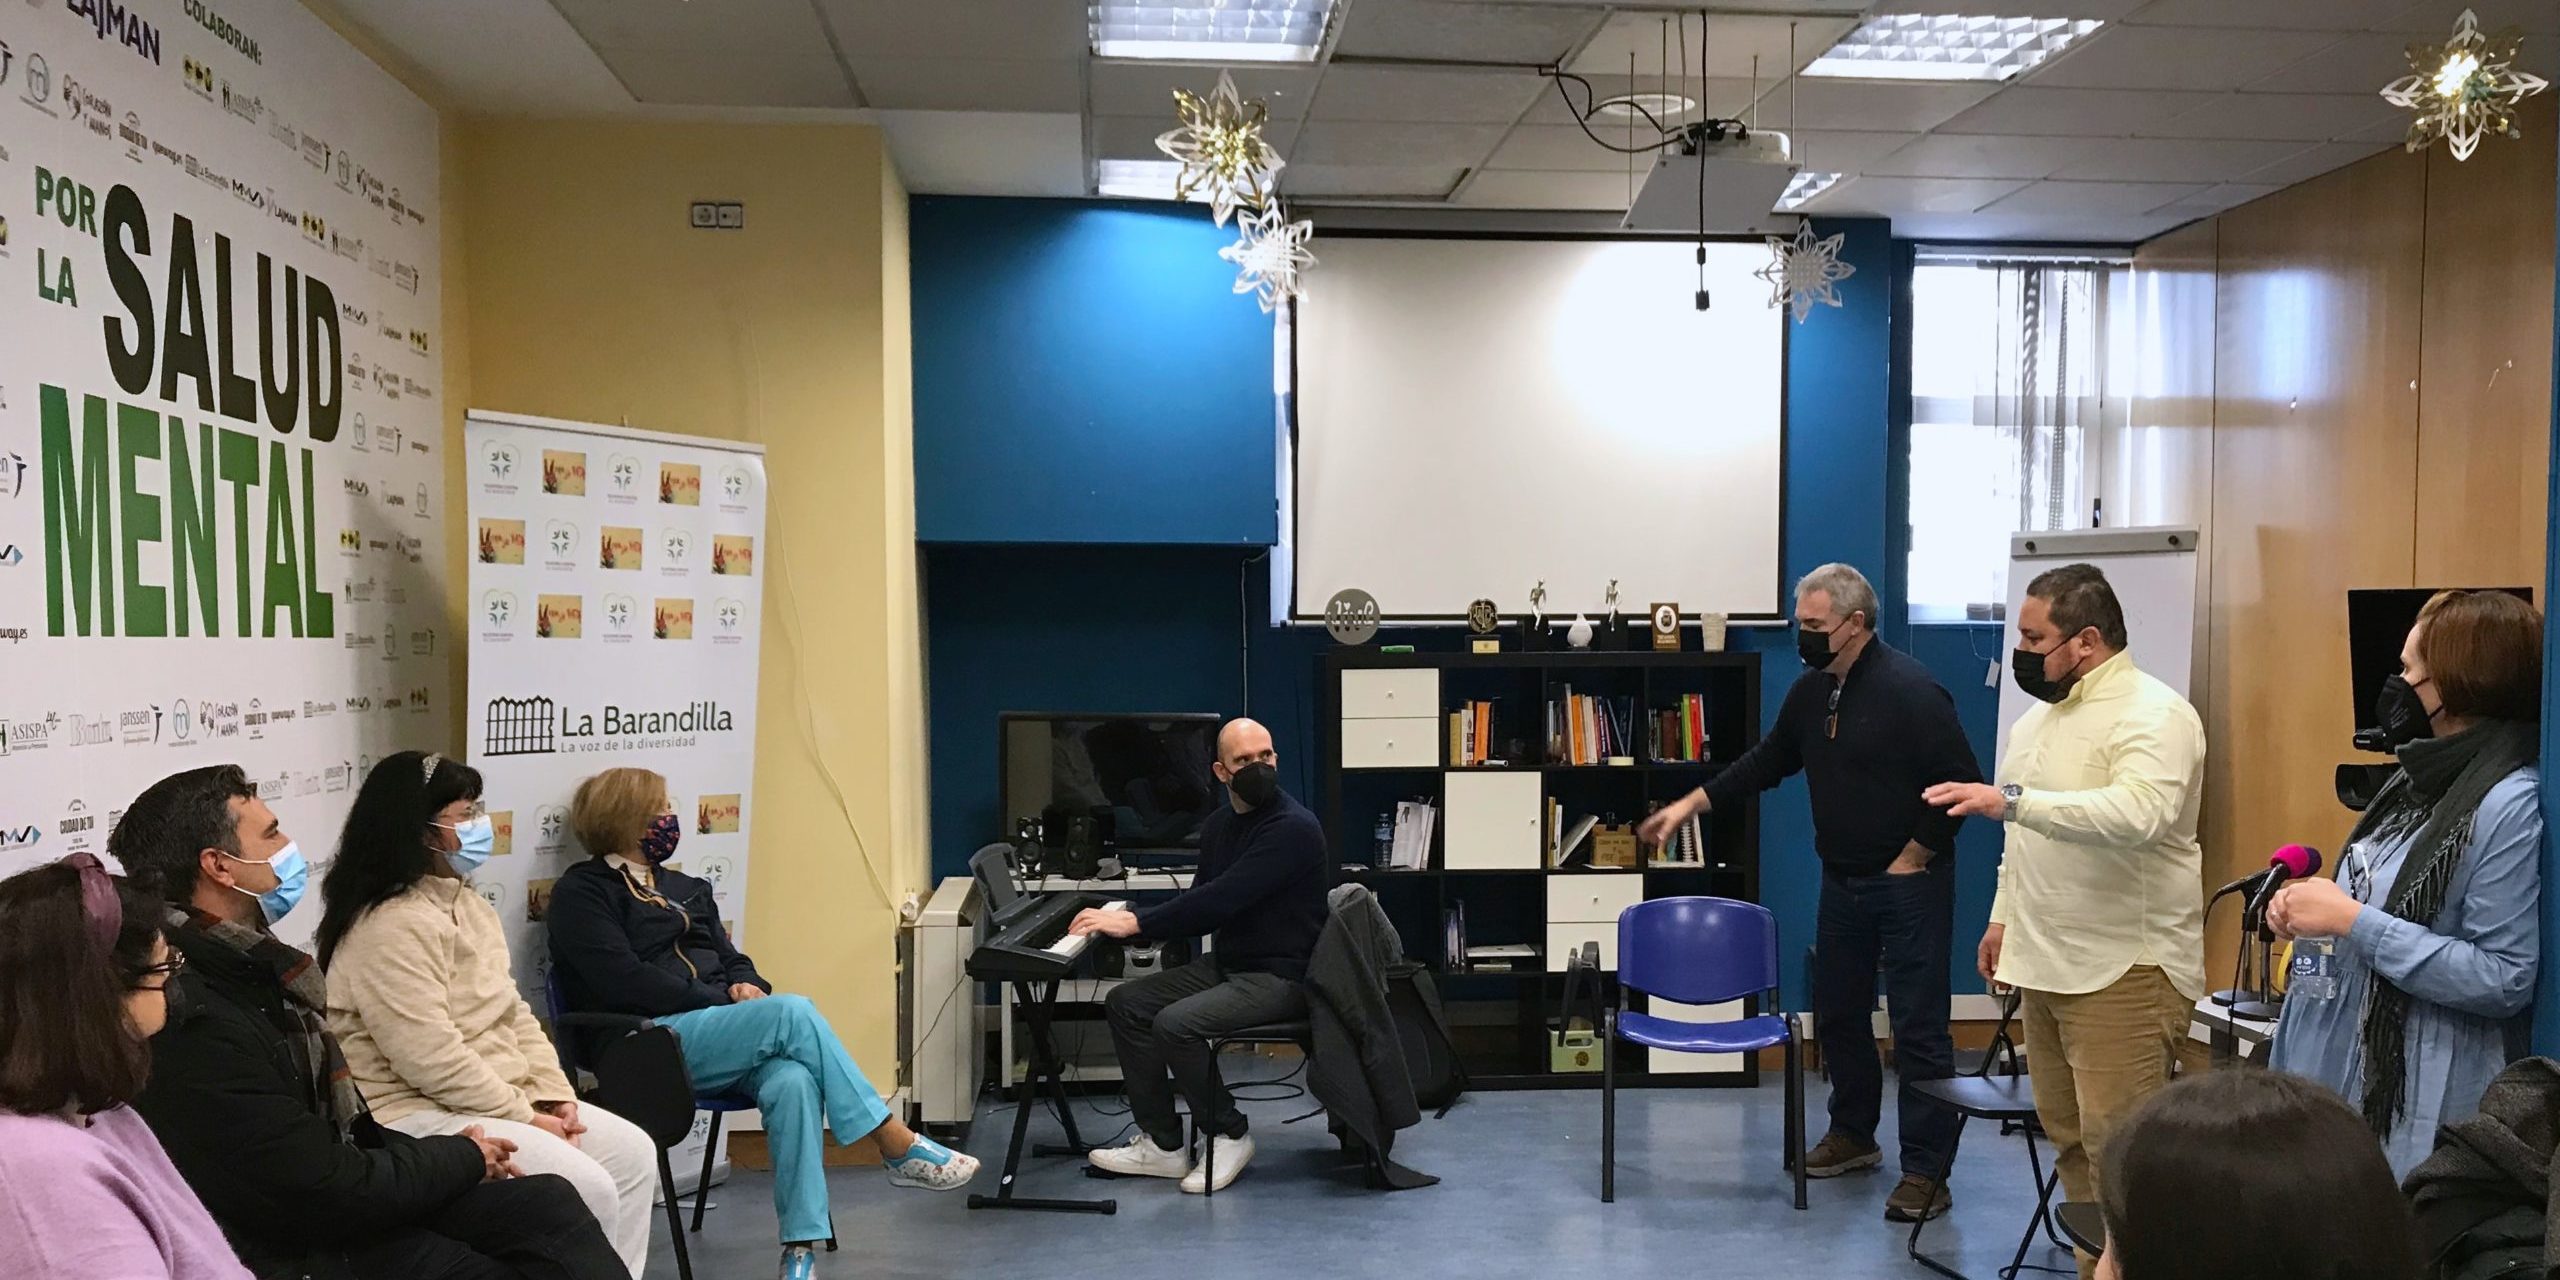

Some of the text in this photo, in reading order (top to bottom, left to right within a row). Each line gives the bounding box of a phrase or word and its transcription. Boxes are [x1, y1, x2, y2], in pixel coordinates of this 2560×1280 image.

[184, 0, 262, 66] COLABORAN:
[35, 165, 97, 238] POR
[37, 247, 78, 308] LA
[102, 184, 343, 443] SALUD
[39, 382, 335, 639] MENTAL
[11, 722, 48, 741] ASISPA
[119, 710, 150, 732] janssen
[561, 735, 696, 753] La voz de la diversidad
[562, 701, 734, 737] La Barandilla
